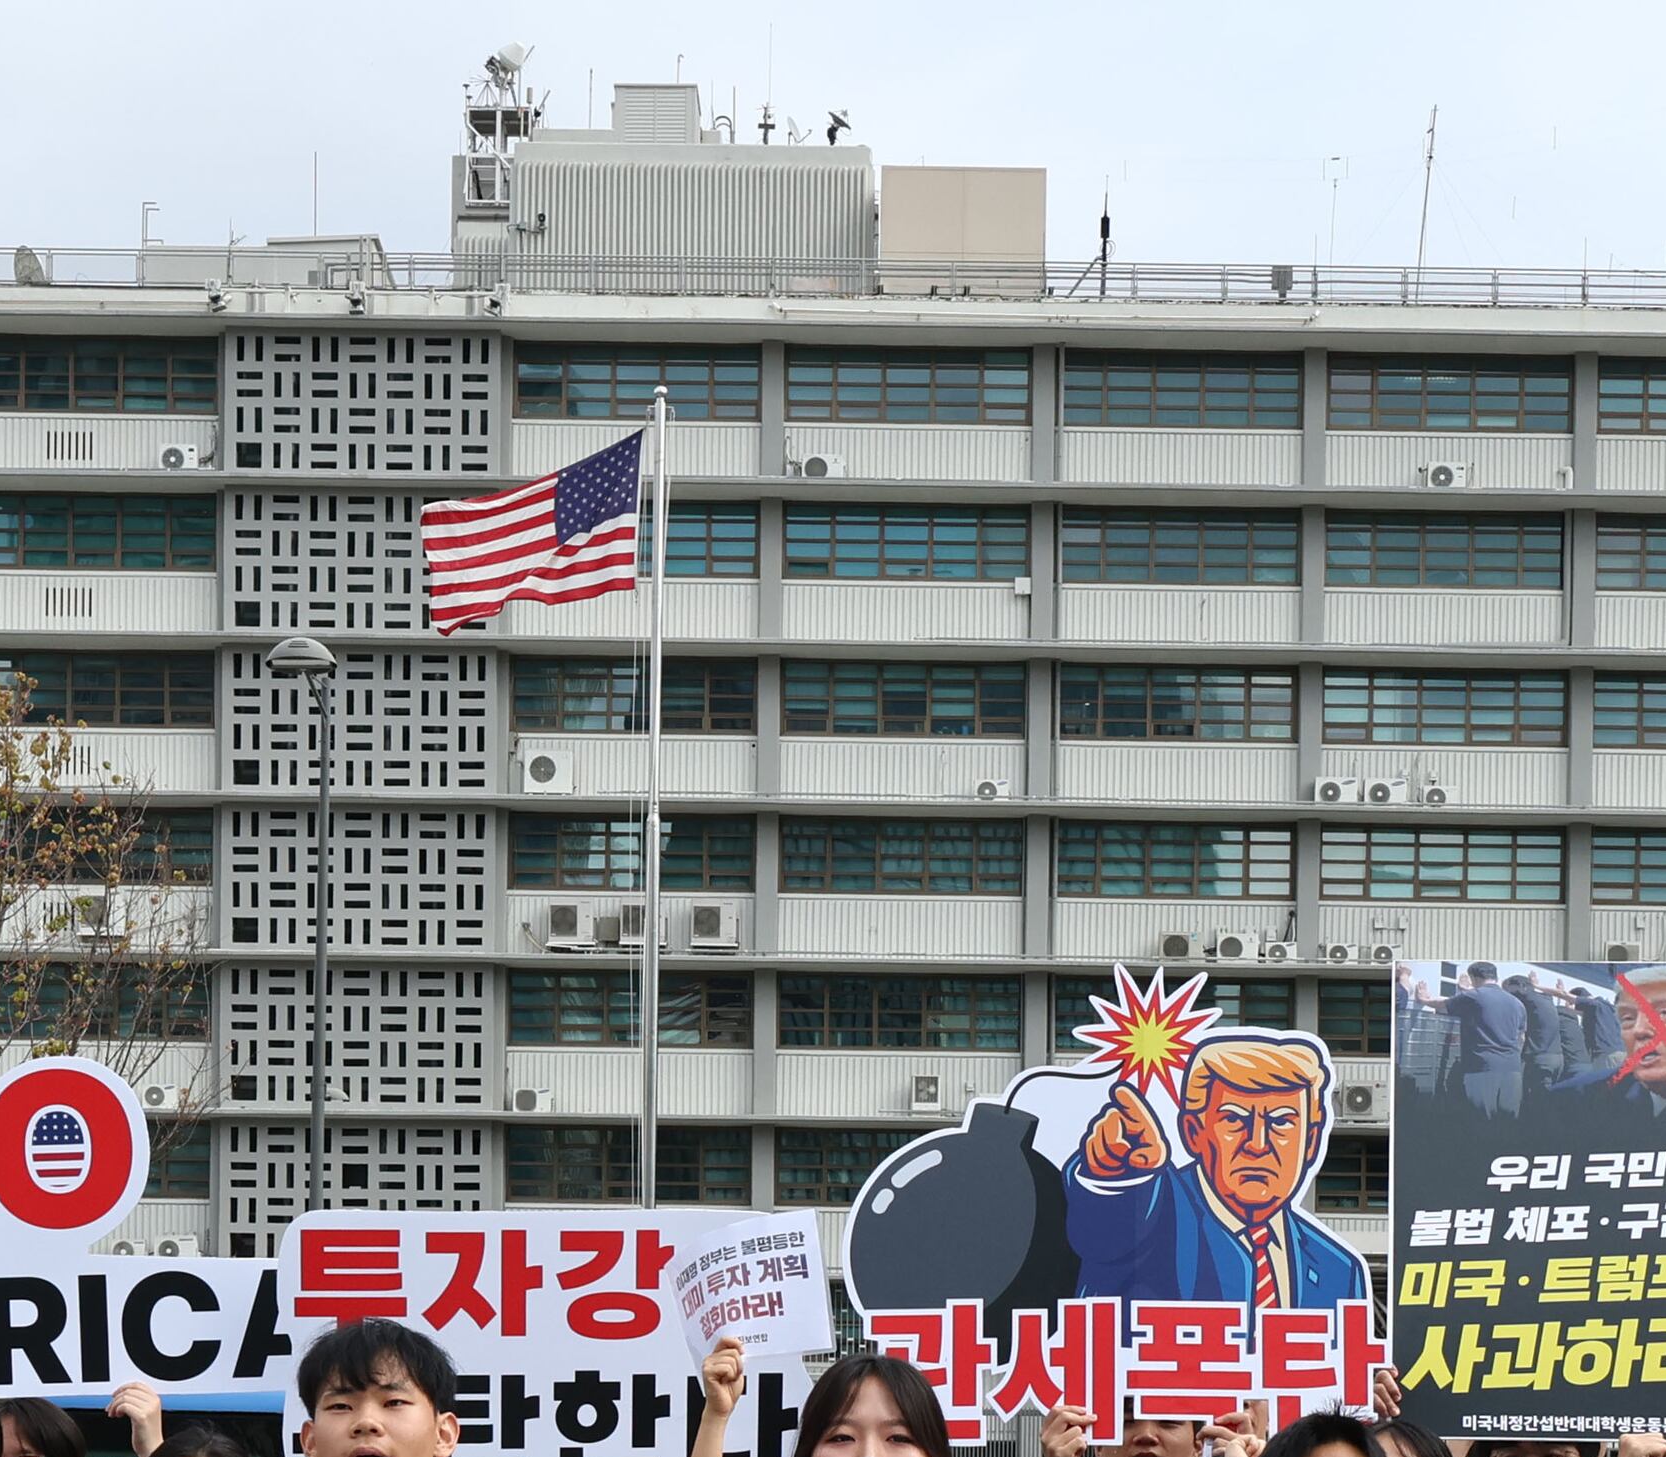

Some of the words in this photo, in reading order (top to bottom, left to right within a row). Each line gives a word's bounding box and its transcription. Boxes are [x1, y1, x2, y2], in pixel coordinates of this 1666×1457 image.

[1487, 1153, 1572, 1193] 우리
[1410, 1208, 1495, 1247] 불법
[699, 1246, 737, 1271] 정부는
[741, 1231, 805, 1255] 불평등한
[707, 1262, 750, 1296] 투자
[757, 1254, 809, 1283] 계획
[700, 1291, 784, 1340] 철회하라!
[870, 1303, 1385, 1439] 관세폭탄
